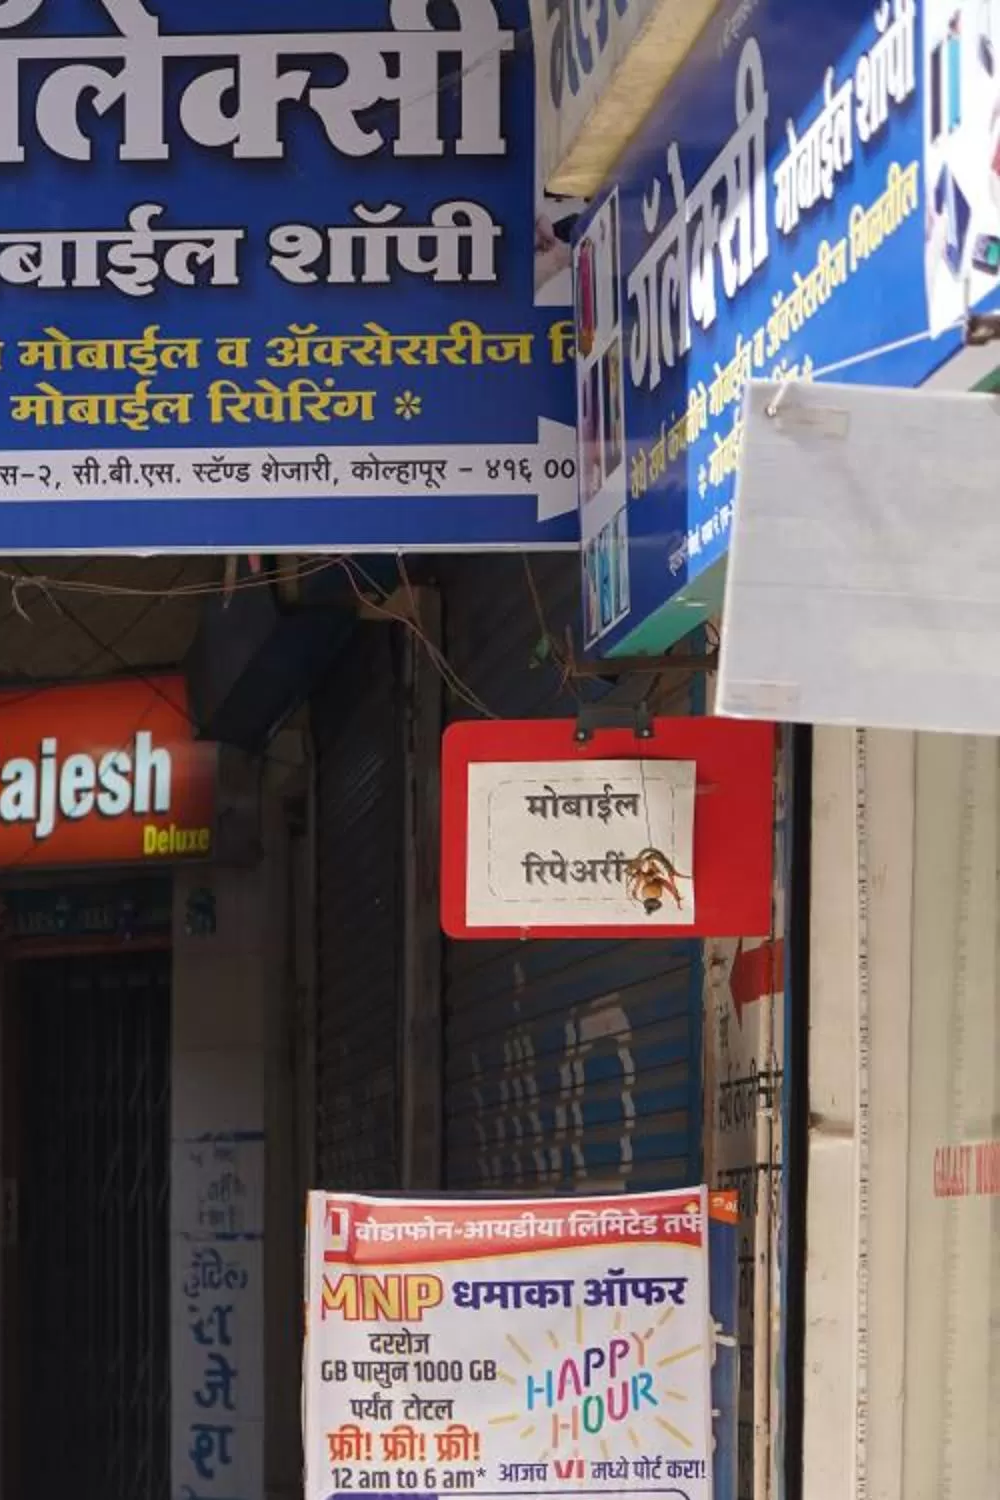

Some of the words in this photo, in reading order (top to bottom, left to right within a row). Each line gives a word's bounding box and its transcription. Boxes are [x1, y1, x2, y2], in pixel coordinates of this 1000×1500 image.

[268, 200, 502, 284] शॉपी
[17, 324, 203, 376] मोबाईल
[217, 337, 249, 368] व
[9, 380, 193, 432] मोबाईल
[207, 378, 377, 423] रिपेरिंग
[351, 453, 447, 490] कोल्हापूर
[525, 783, 640, 825] मोबाईल
[142, 823, 210, 855] Deluxe
[521, 850, 643, 886] रिपेअरीं
[568, 1209, 658, 1239] लिमिटेड
[320, 1272, 444, 1322] MNP
[452, 1277, 574, 1309] धमाका
[582, 1267, 688, 1307] ऑफर
[367, 1327, 430, 1355] दररोज
[352, 1360, 410, 1389] पासुन
[413, 1360, 463, 1382] 1000
[469, 1360, 498, 1382] GB
[526, 1327, 655, 1412] HAPPY
[349, 1391, 394, 1421] पर्यंत
[401, 1393, 455, 1421] टोटल
[551, 1371, 659, 1450] HOUR
[326, 1423, 373, 1462] फ्री!
[379, 1423, 426, 1462] फ्री!
[433, 1423, 482, 1462] फ्री!
[331, 1466, 353, 1489] 12
[358, 1470, 391, 1489] am
[395, 1468, 418, 1489] to
[423, 1467, 437, 1489] 6
[498, 1462, 549, 1483] आजच
[590, 1456, 629, 1480] मध्ये
[631, 1455, 663, 1480] पोर्ट
[666, 1459, 707, 1480] करा!
